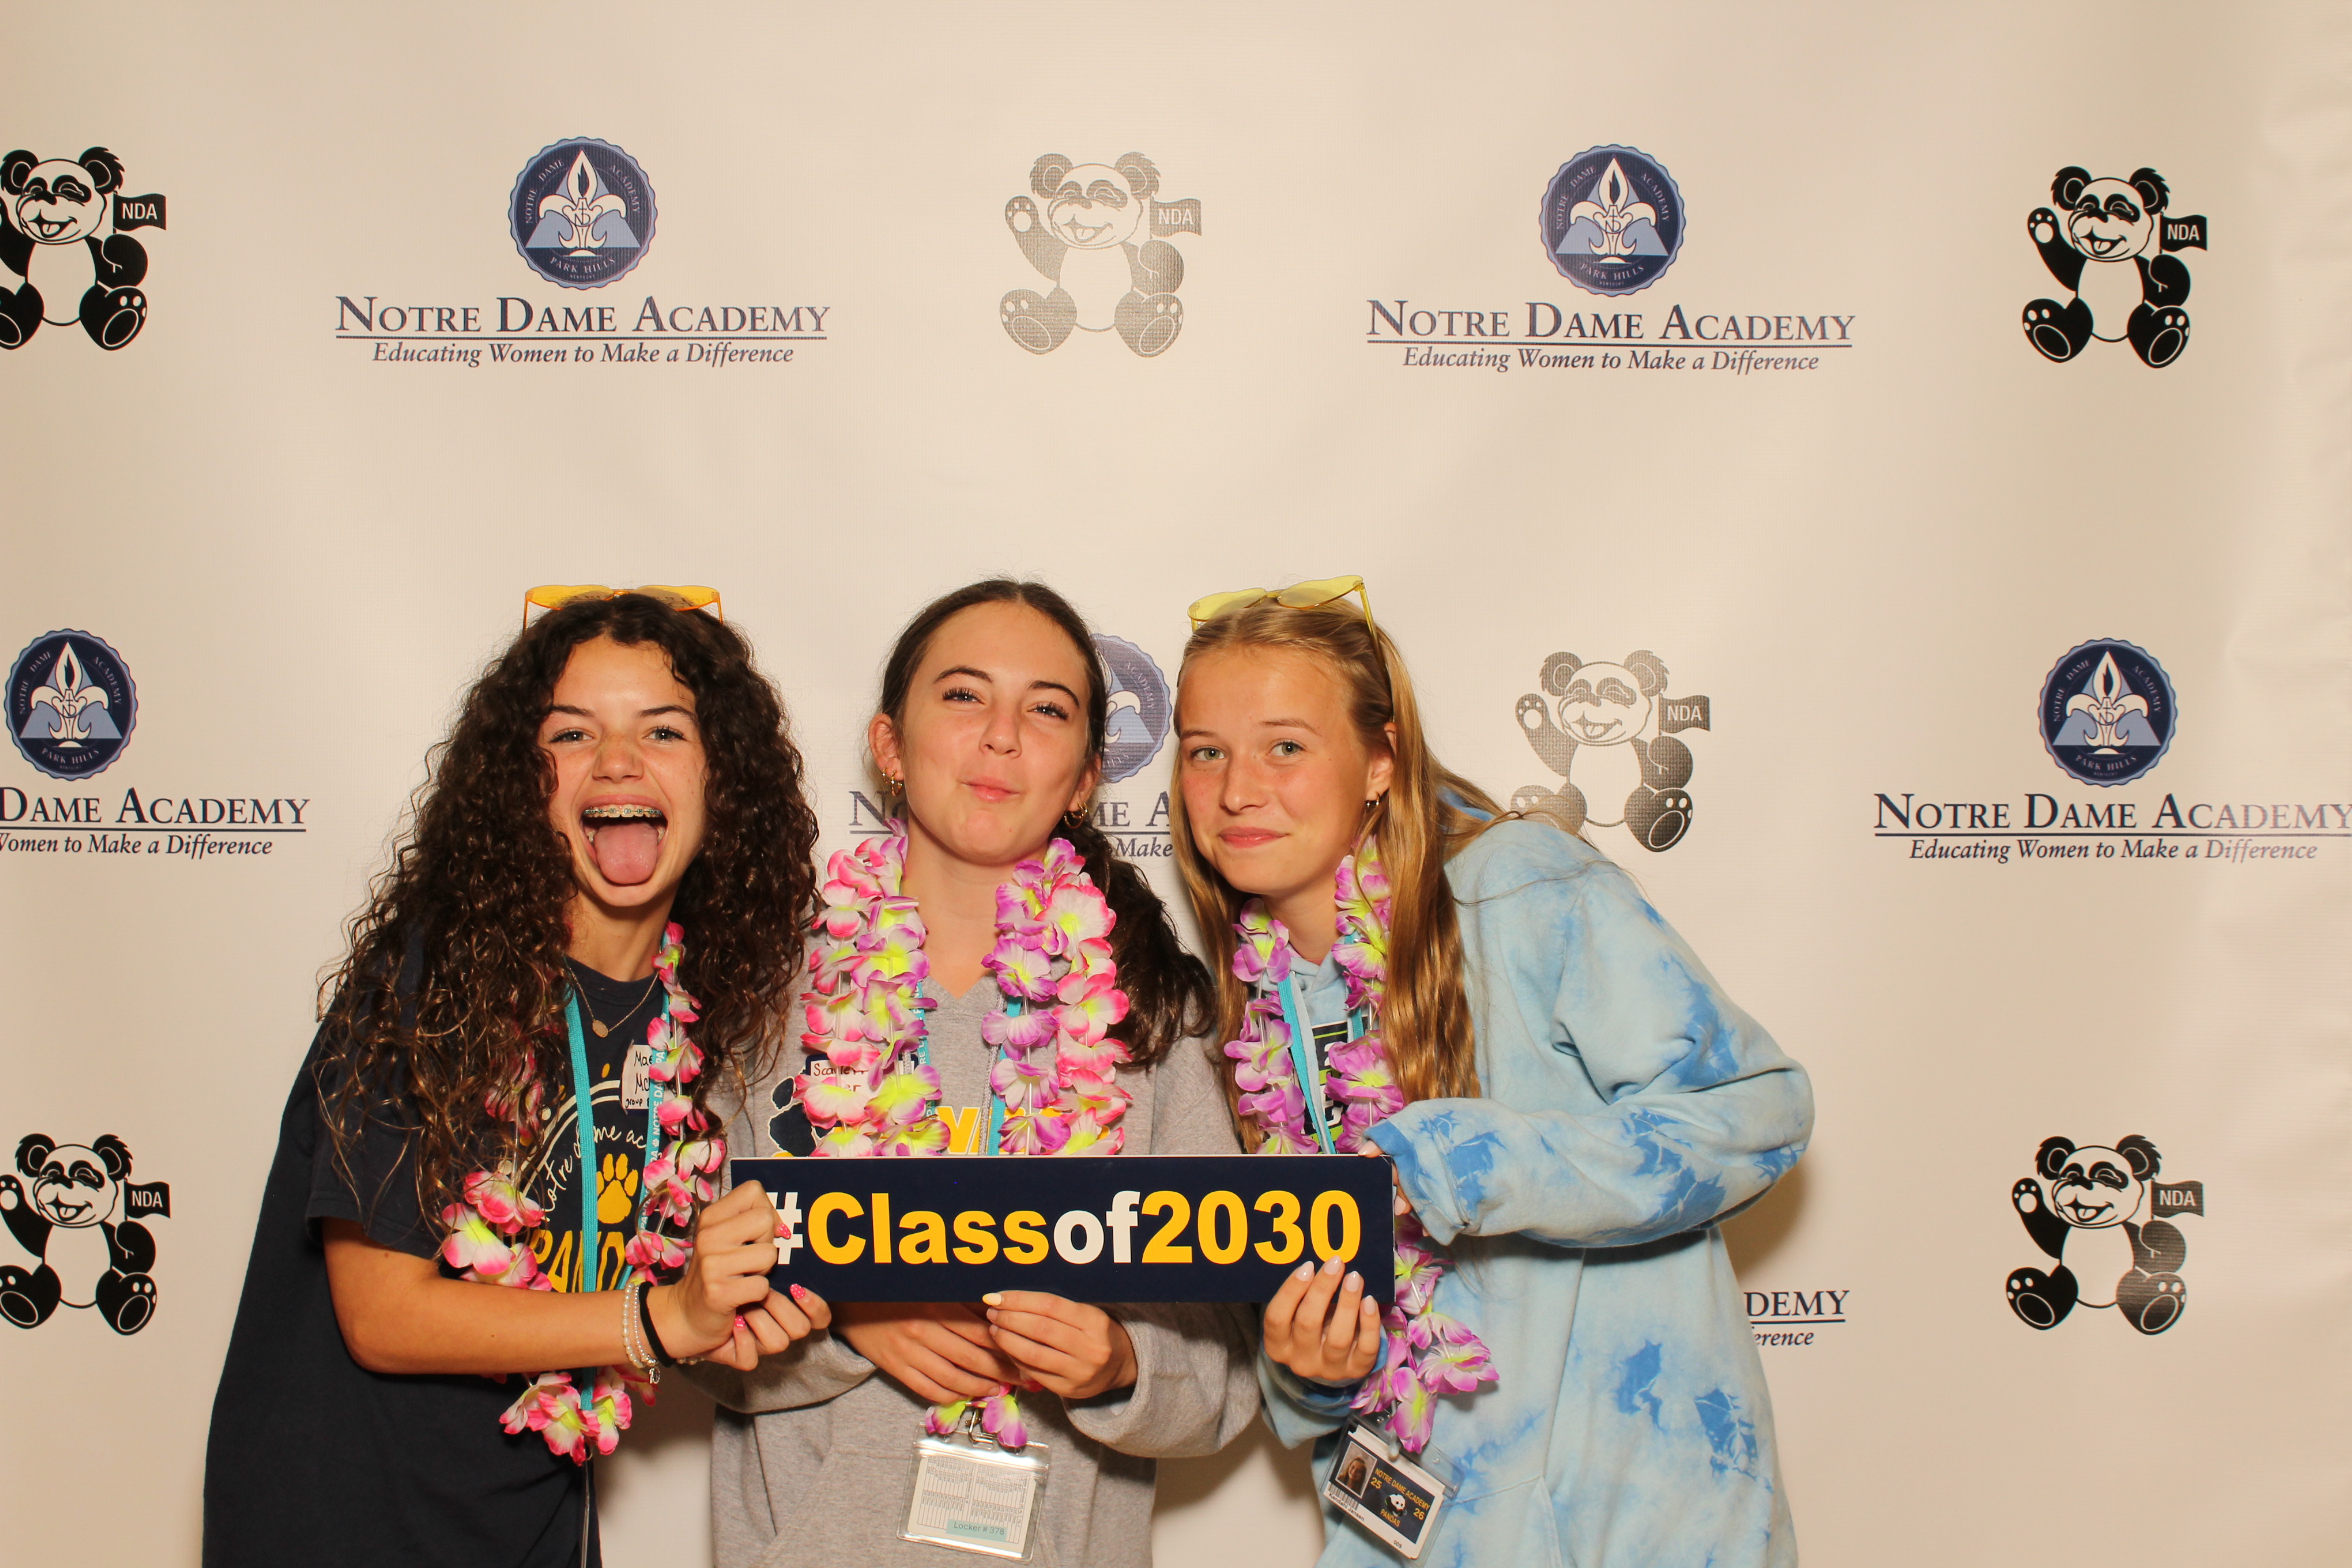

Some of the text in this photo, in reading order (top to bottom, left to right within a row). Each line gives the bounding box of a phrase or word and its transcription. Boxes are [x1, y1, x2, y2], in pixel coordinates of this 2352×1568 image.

[122, 203, 158, 220] NDA
[1158, 208, 1194, 225] NDA
[2167, 224, 2200, 241] NDA
[336, 296, 830, 331] NOTRE DAME ACADEMY
[1367, 300, 1855, 340] NOTRE DAME ACADEMY
[373, 342, 793, 368] Educating Women to Make a Difference
[1403, 347, 1818, 375] Educating Women to Make a Difference
[1667, 705, 1702, 721] NDA
[0, 787, 310, 823] DAME ACADEMY
[1874, 794, 2352, 828] NOTRE DAME ACADEMY
[65, 837, 82, 852] to
[88, 834, 141, 853] Make
[148, 841, 159, 853] a
[166, 834, 272, 859] Difference
[1115, 837, 1173, 858] Make
[1910, 838, 2317, 864] Educating Women to Make a Difference
[131, 1190, 163, 1208] NDA
[2159, 1190, 2197, 1207] NDA
[766, 1190, 1361, 1265] #Classof2030
[1744, 1290, 1849, 1316] DEMY
[1754, 1332, 1814, 1346] erence
[1370, 1477, 1382, 1489] 25
[1375, 1468, 1431, 1511] NOTRE DAME ACADEMY
[1380, 1509, 1401, 1527] PANDAS
[1413, 1507, 1425, 1520] 26
[953, 1521, 981, 1532] Locker
[990, 1526, 1004, 1535] 378
